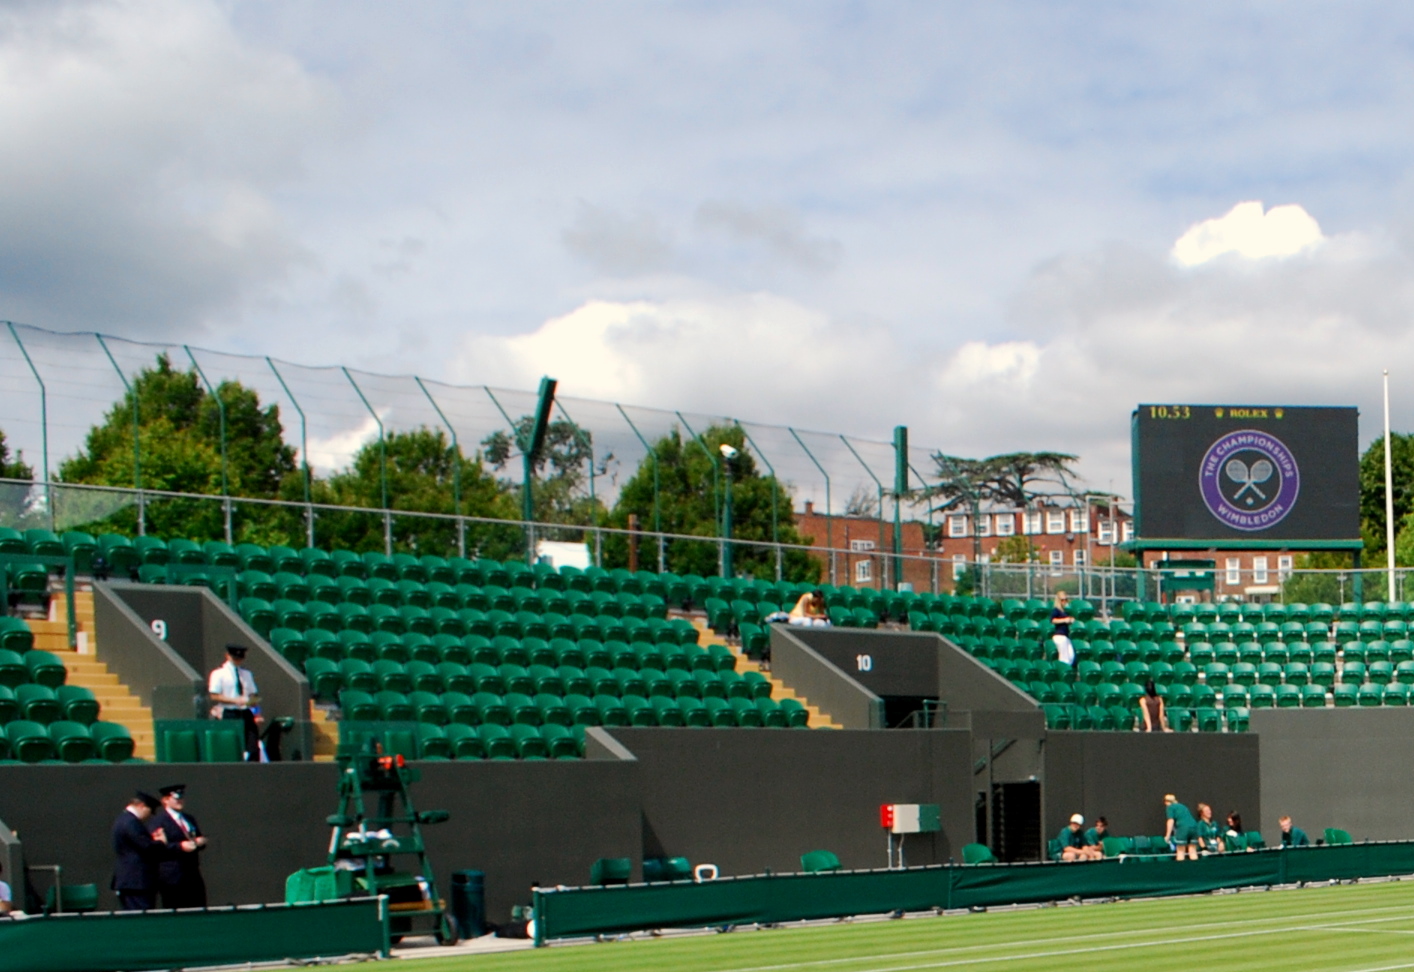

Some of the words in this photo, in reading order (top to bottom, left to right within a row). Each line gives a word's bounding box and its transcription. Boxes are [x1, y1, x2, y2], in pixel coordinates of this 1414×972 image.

[1149, 405, 1191, 419] 10.53
[1229, 408, 1268, 418] ROLEX
[1204, 452, 1219, 477] THE
[1216, 434, 1294, 478] CHAMPIONSHIPS
[1217, 503, 1283, 526] WIMBLEDON
[151, 619, 166, 640] 9
[856, 654, 872, 671] 10
